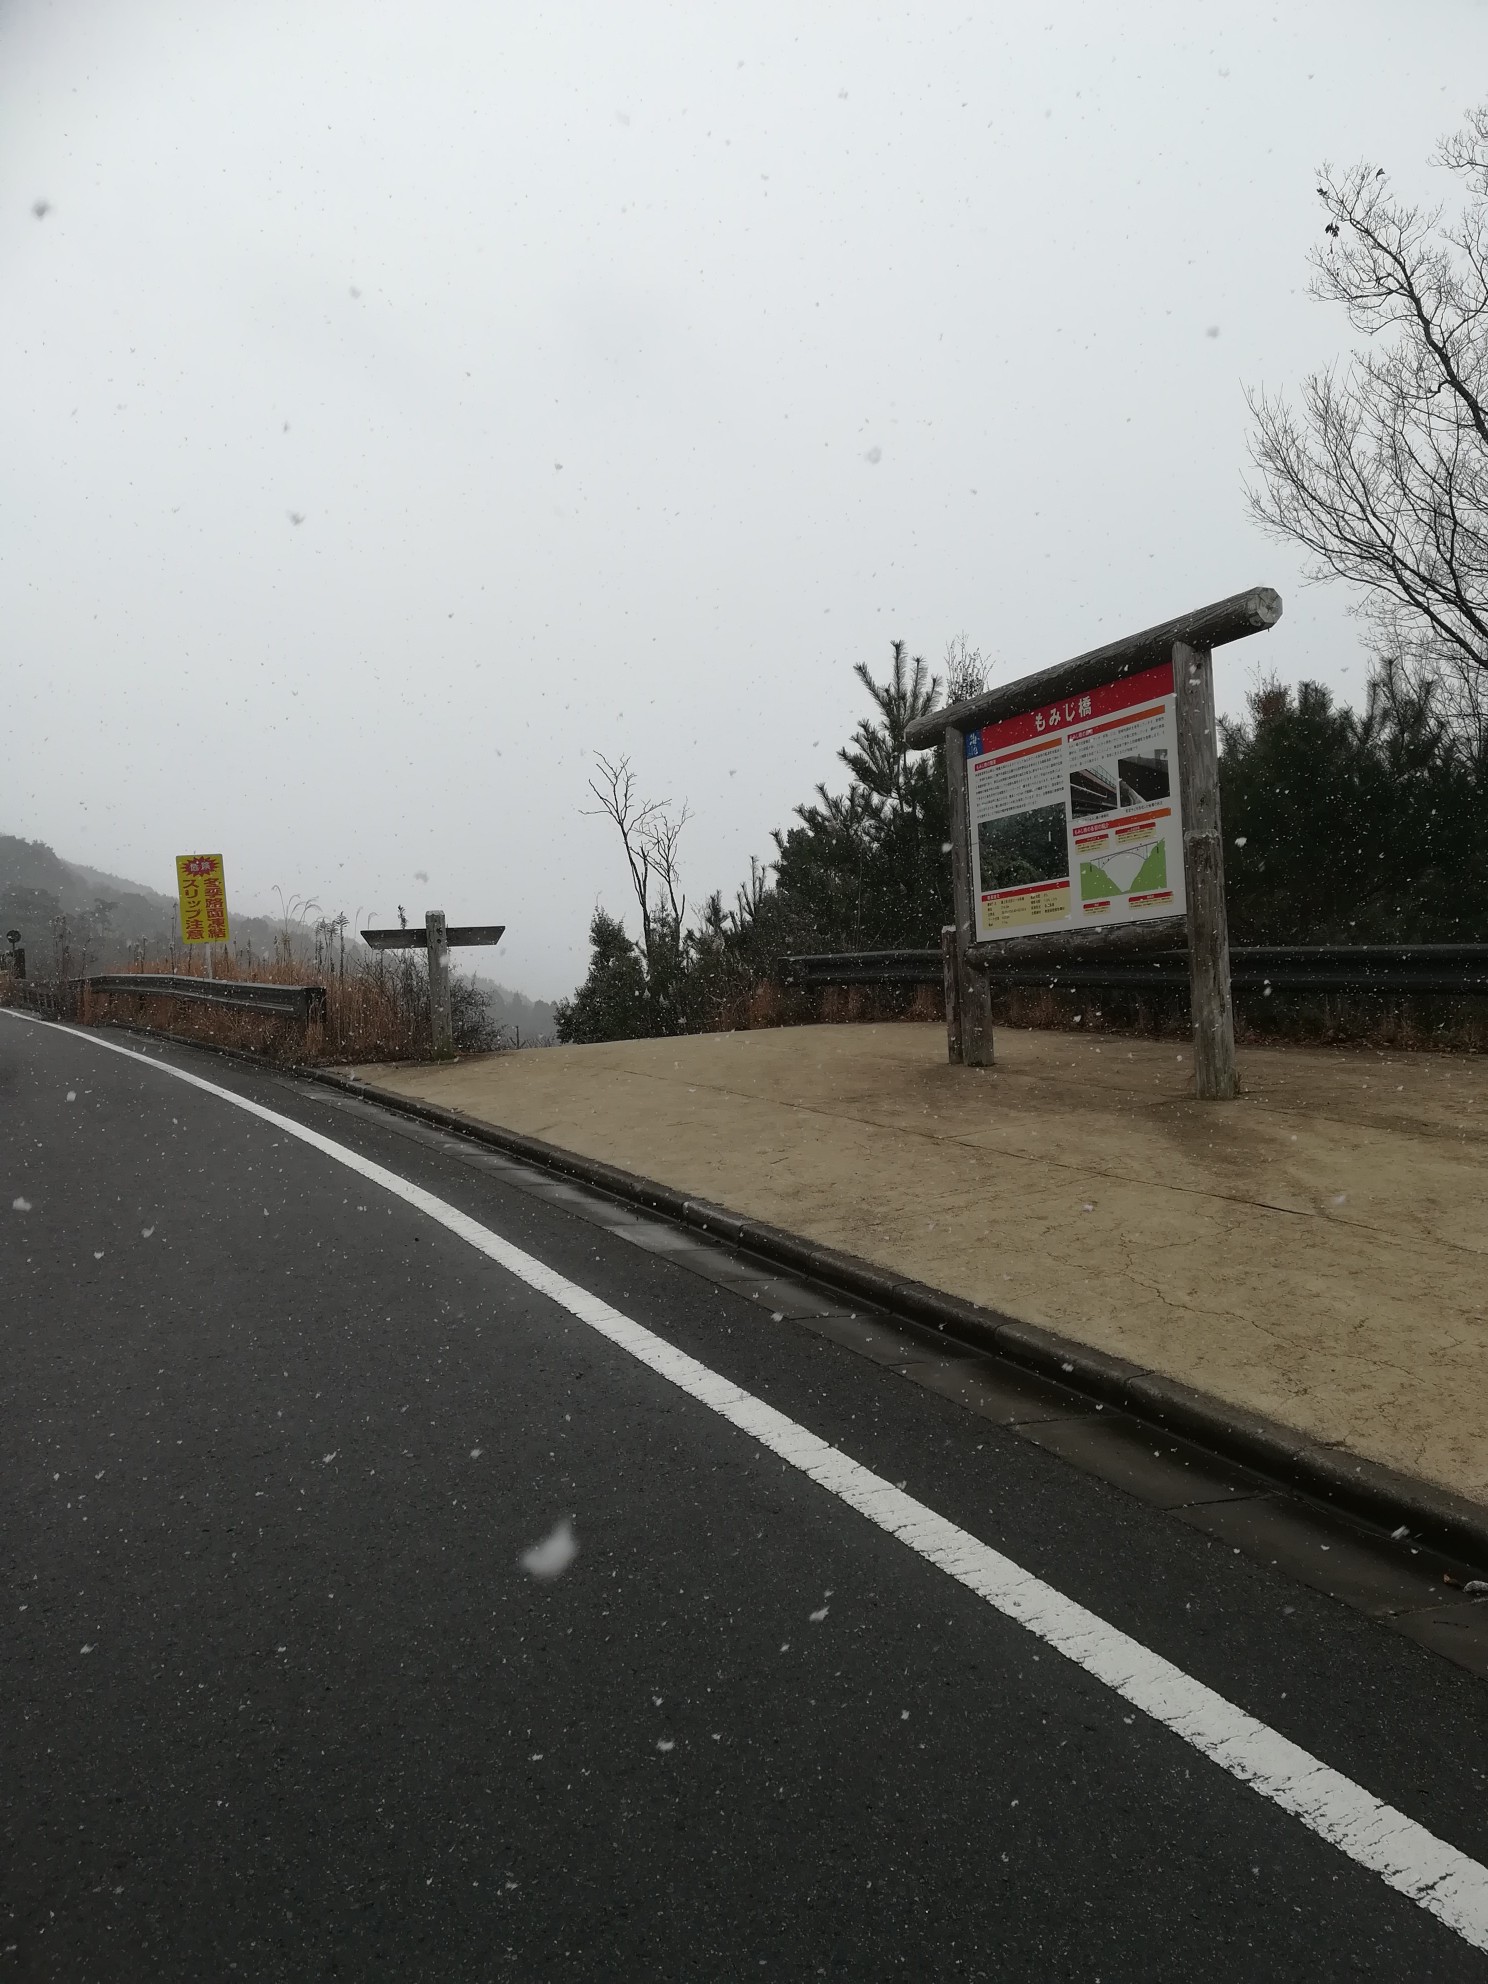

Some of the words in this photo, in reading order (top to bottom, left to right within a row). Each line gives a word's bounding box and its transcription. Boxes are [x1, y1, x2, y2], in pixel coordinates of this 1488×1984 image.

[1035, 696, 1092, 732] もみじ橋
[183, 879, 204, 940] スリップ注意
[204, 878, 226, 938] 冬季路面凍結
